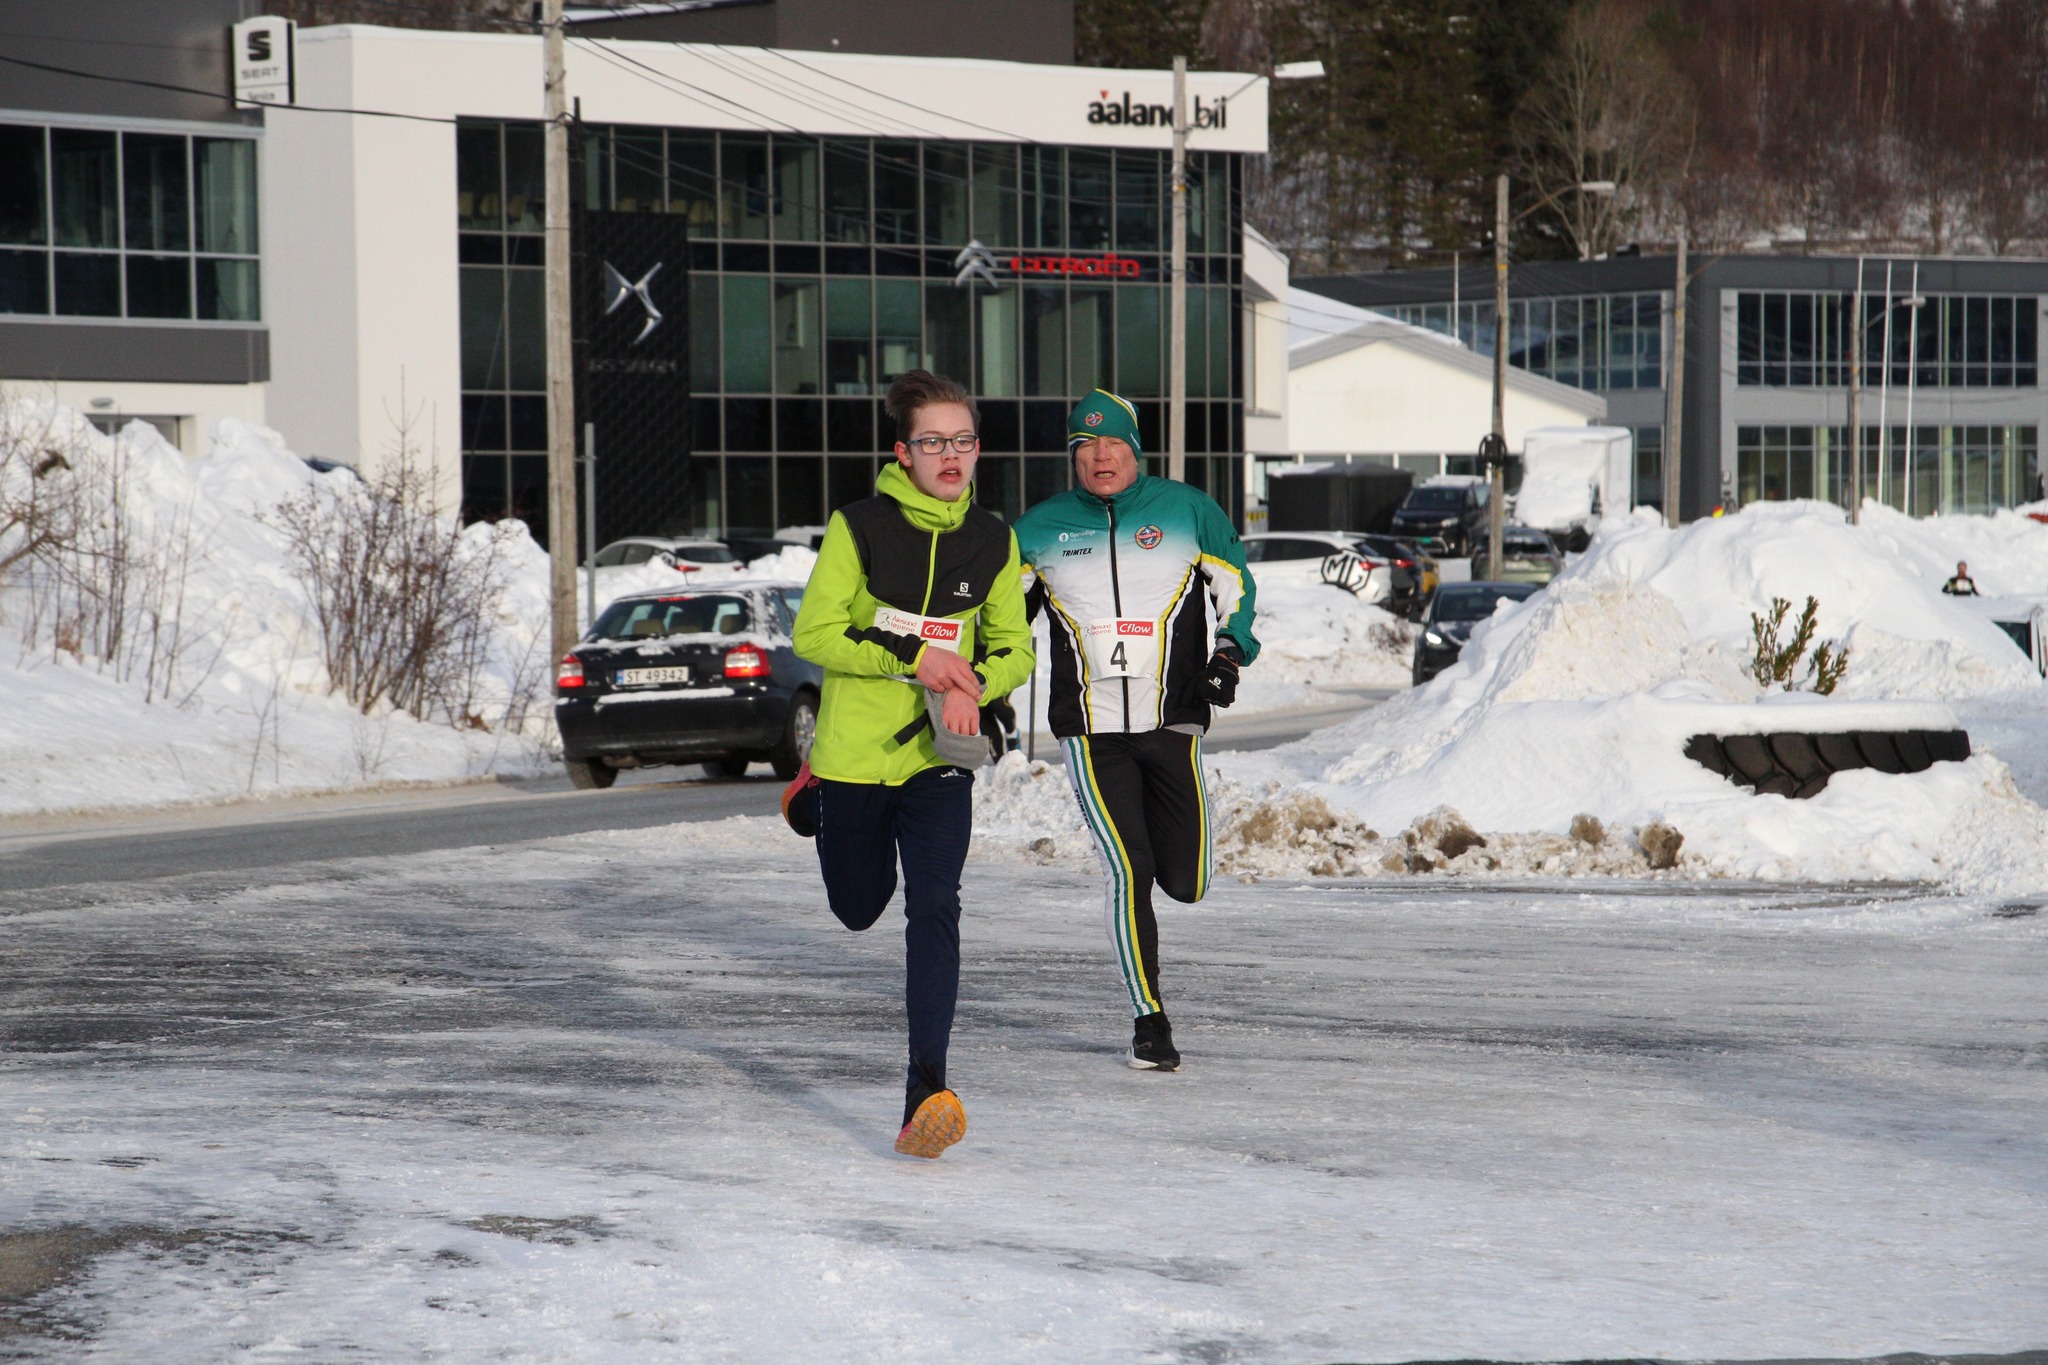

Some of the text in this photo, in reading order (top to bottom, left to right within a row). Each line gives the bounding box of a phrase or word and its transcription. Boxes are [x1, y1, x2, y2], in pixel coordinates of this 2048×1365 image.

[241, 66, 279, 79] SEAT
[1194, 95, 1227, 129] bil
[1062, 547, 1093, 557] TRIMTEX
[1110, 641, 1128, 671] 4
[627, 668, 684, 683] ST 49342
